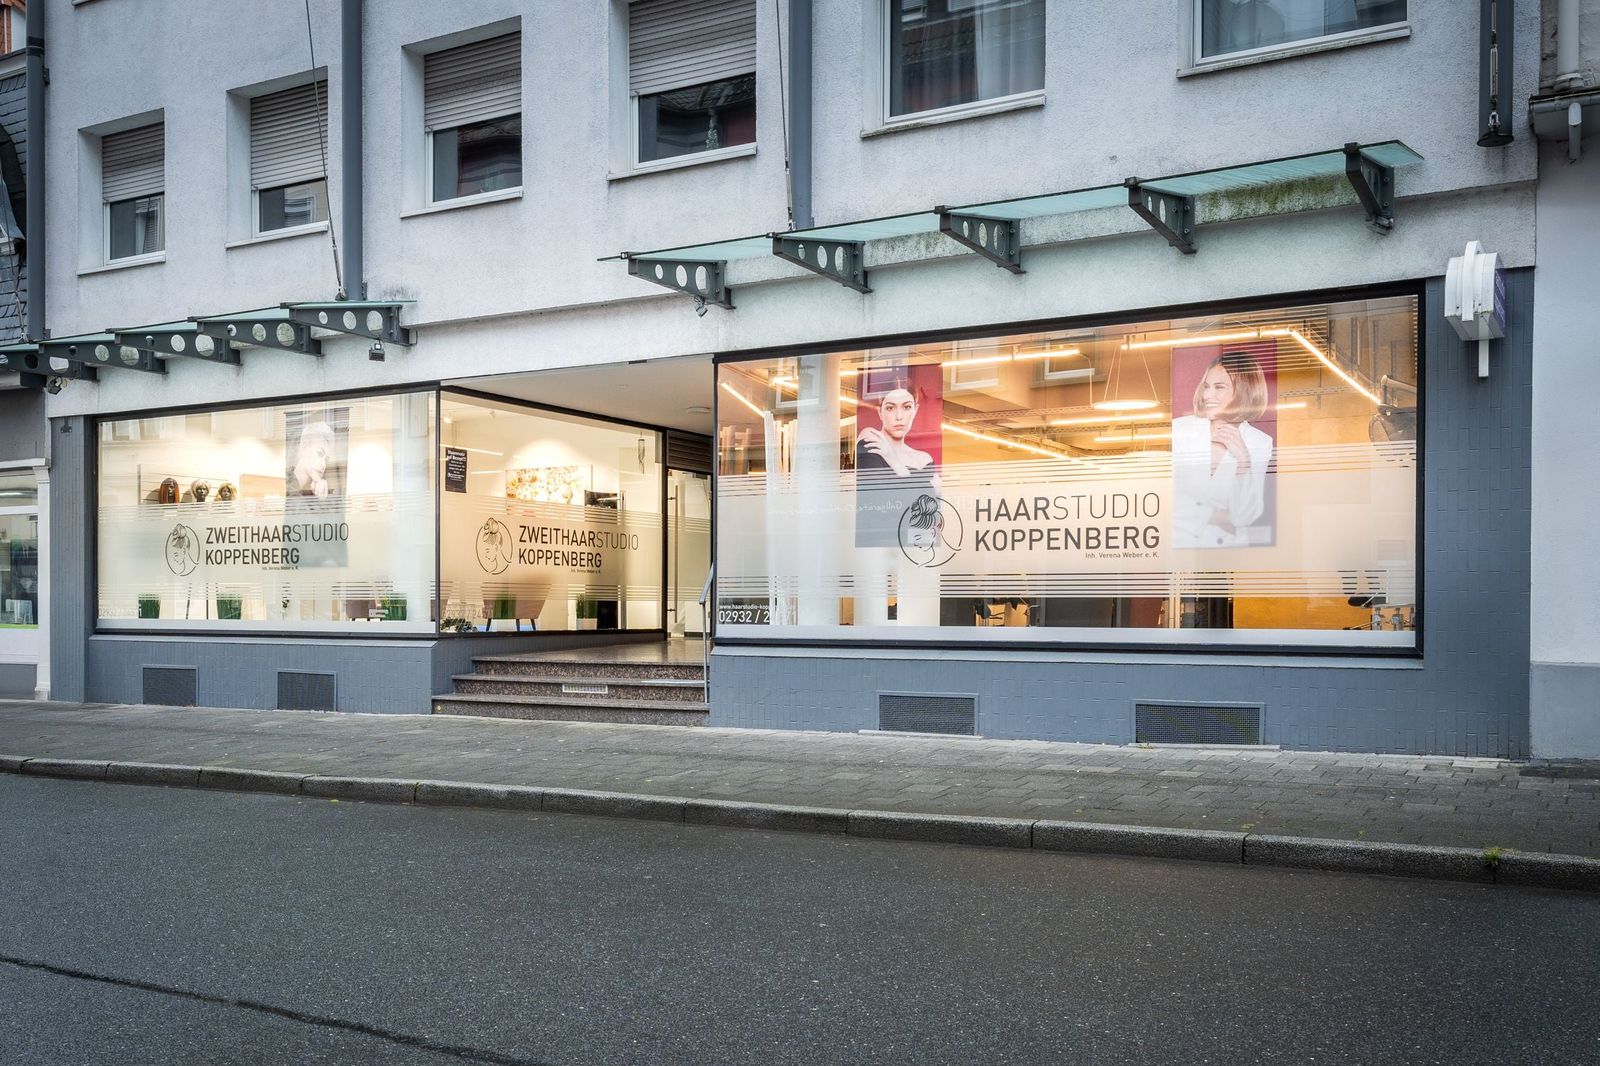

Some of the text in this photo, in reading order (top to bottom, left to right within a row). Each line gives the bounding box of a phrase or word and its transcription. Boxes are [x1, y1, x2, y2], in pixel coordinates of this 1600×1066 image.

[975, 492, 1160, 522] HAARSTUDIO
[205, 522, 349, 544] ZWEITHAARSTUDIO
[519, 525, 639, 550] ZWEITHAARSTUDIO
[975, 525, 1160, 551] KOPPENBERG
[205, 547, 300, 565] KOPPENBERG
[518, 548, 602, 568] KOPPENBERG
[719, 610, 752, 623] 02932
[755, 609, 761, 624] /
